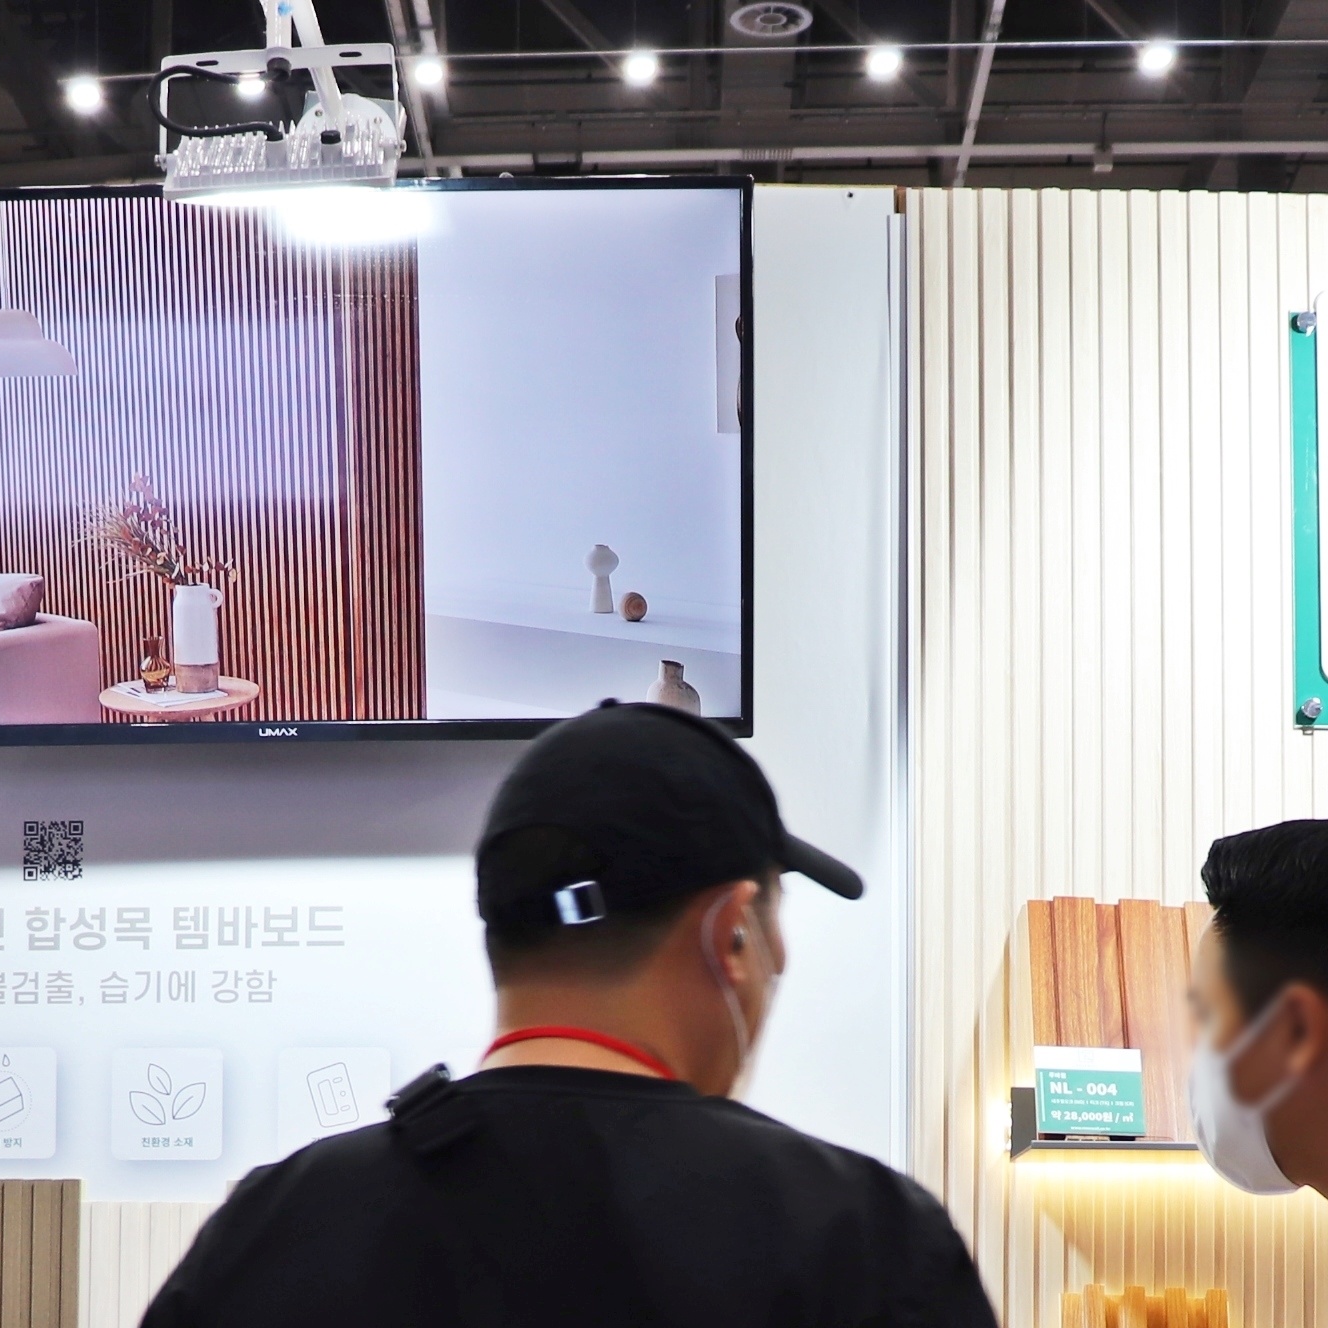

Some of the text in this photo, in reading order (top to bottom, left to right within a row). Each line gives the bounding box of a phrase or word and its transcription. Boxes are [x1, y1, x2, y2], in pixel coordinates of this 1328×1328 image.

[259, 727, 298, 737] UMAX
[25, 904, 154, 951] 합성목
[172, 904, 346, 951] 템바보드
[99, 968, 197, 1005] 습기에
[211, 967, 278, 1004] 강함
[1050, 1081, 1073, 1095] NL
[1086, 1082, 1118, 1096] 004
[1064, 1110, 1114, 1123] 28,000원
[3, 1137, 23, 1149] 방지
[140, 1137, 194, 1149] 친환경 소재
